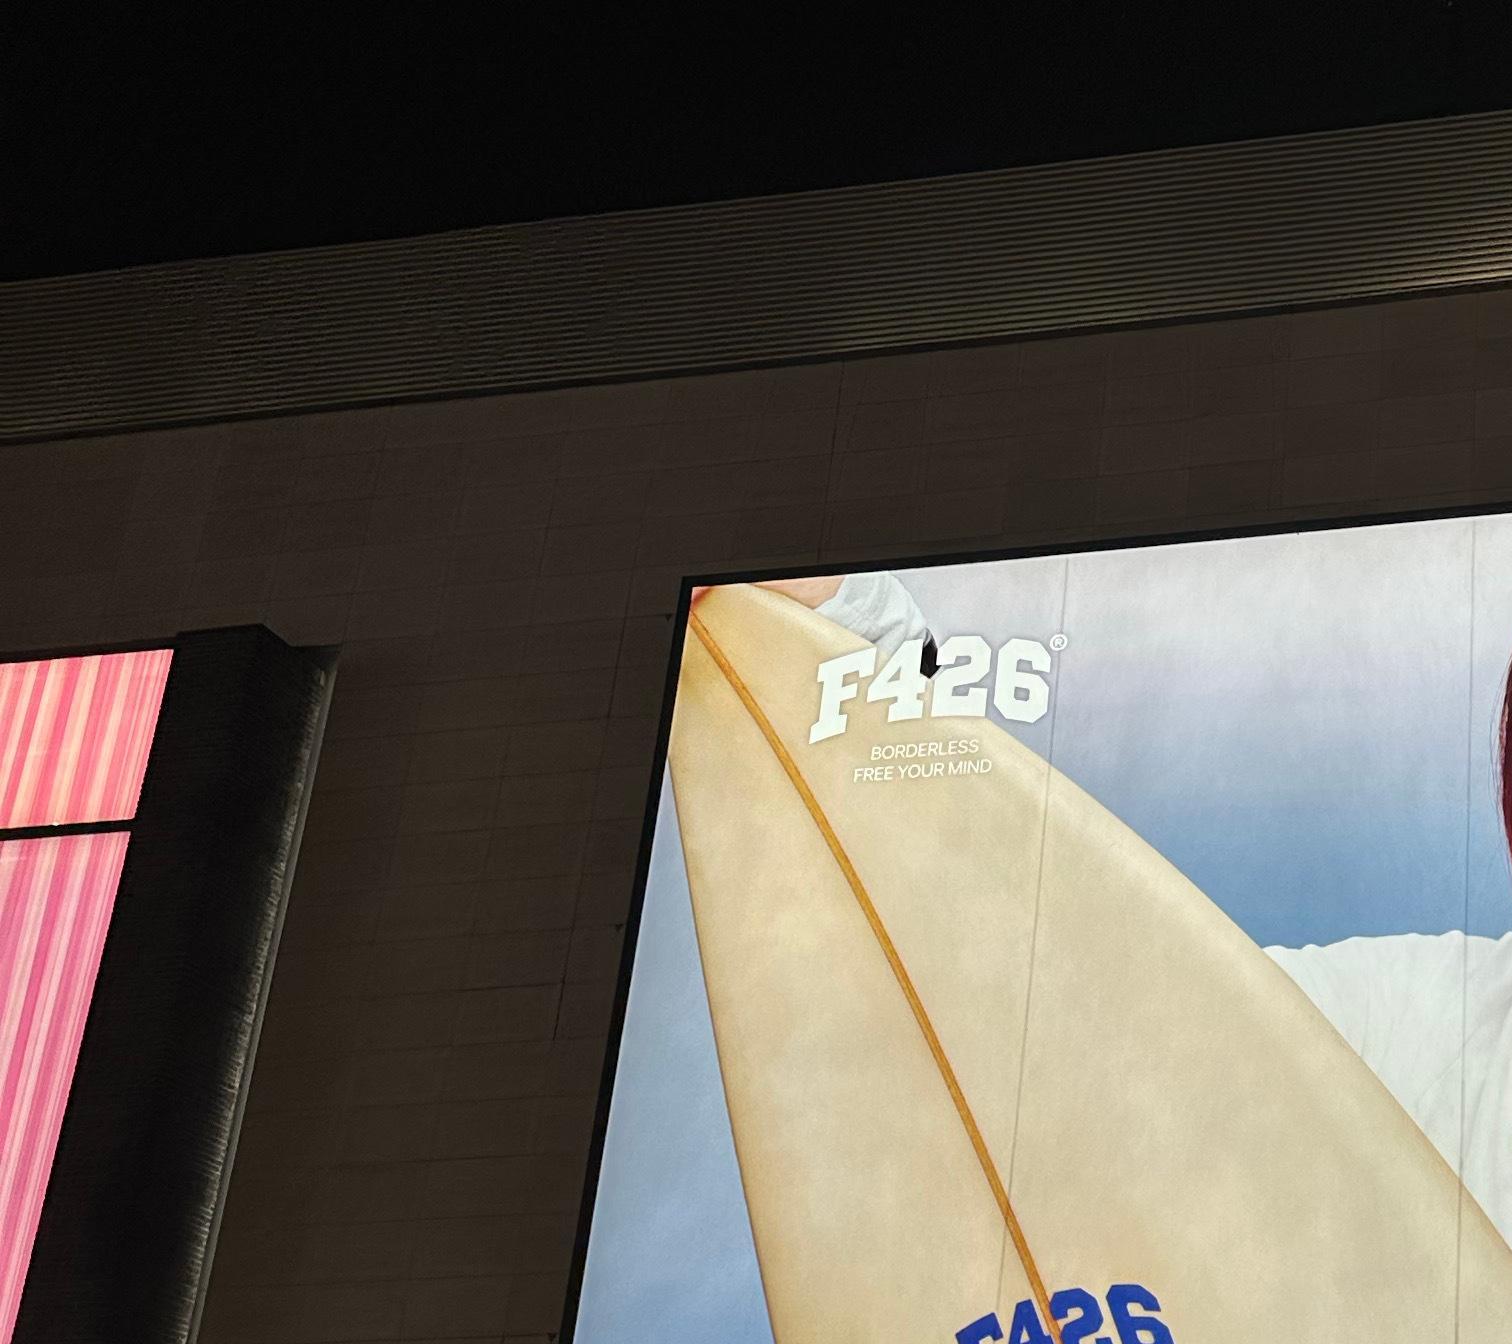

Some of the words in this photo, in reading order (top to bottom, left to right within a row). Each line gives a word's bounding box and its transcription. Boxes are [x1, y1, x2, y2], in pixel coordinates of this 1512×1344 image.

[871, 739, 980, 761] BORDERLESS
[853, 765, 895, 783] FREE
[898, 763, 945, 779] YOUR
[948, 758, 992, 776] MIND
